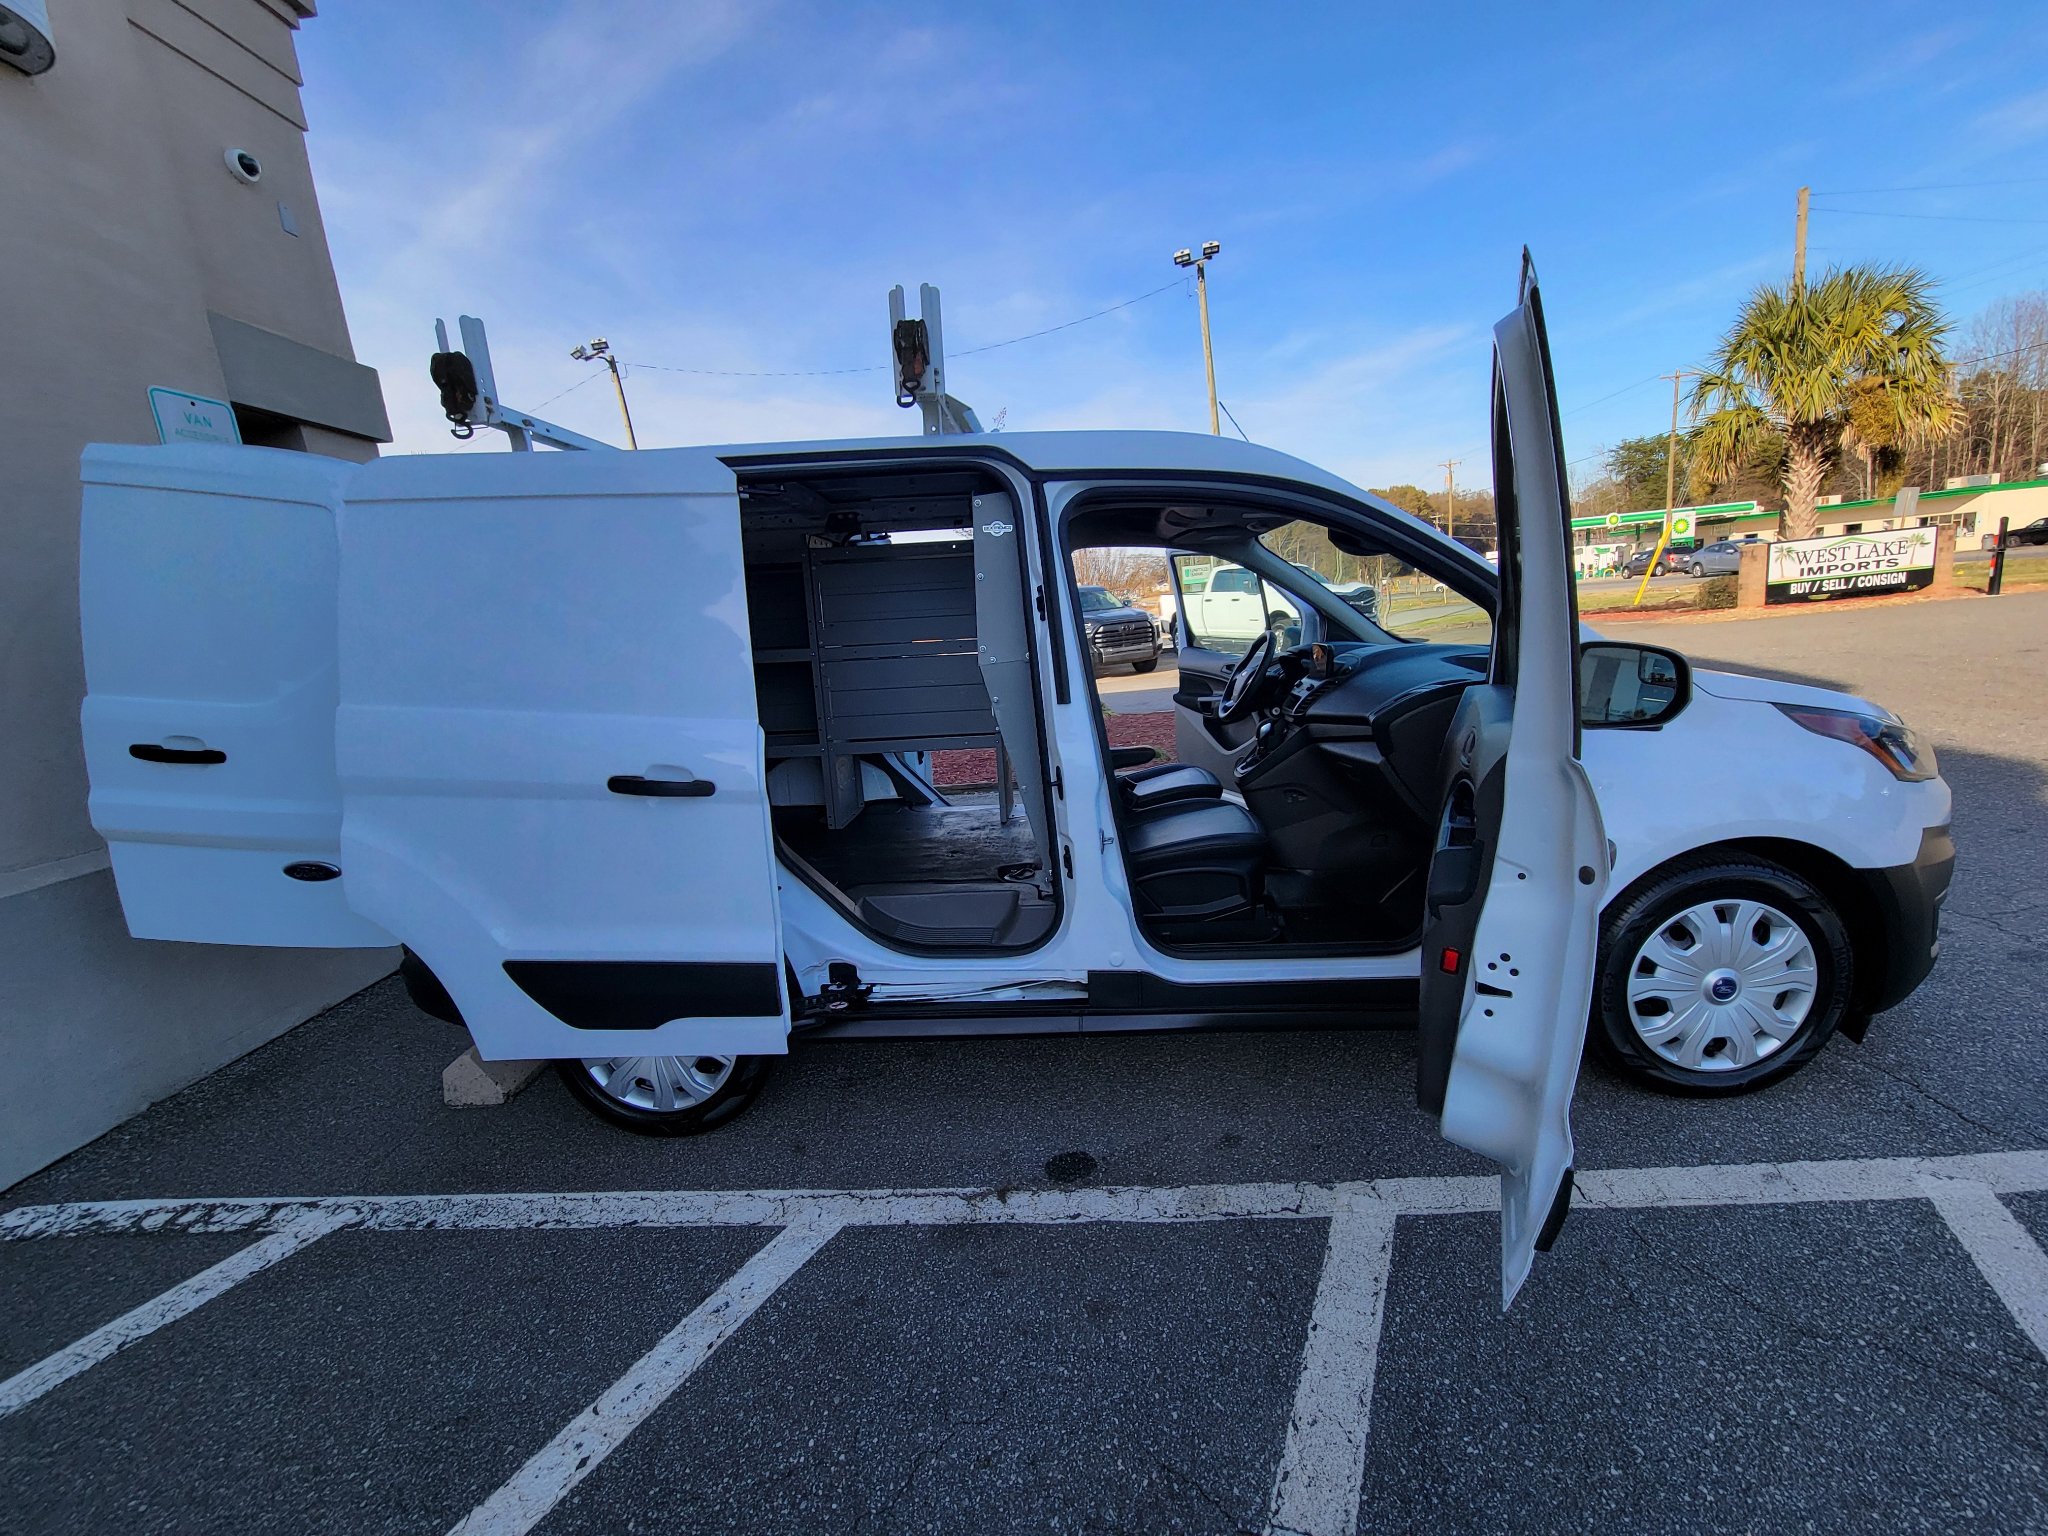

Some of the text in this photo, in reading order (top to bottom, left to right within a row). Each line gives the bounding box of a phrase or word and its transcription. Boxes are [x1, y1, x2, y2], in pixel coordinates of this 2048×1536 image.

[183, 411, 212, 428] VAN
[1795, 540, 1909, 566] WEST LAKE
[1799, 558, 1900, 577] IMPORTS
[1790, 582, 1812, 594] BUY
[1821, 578, 1847, 592] SELL
[1857, 572, 1907, 587] CONSIGN
